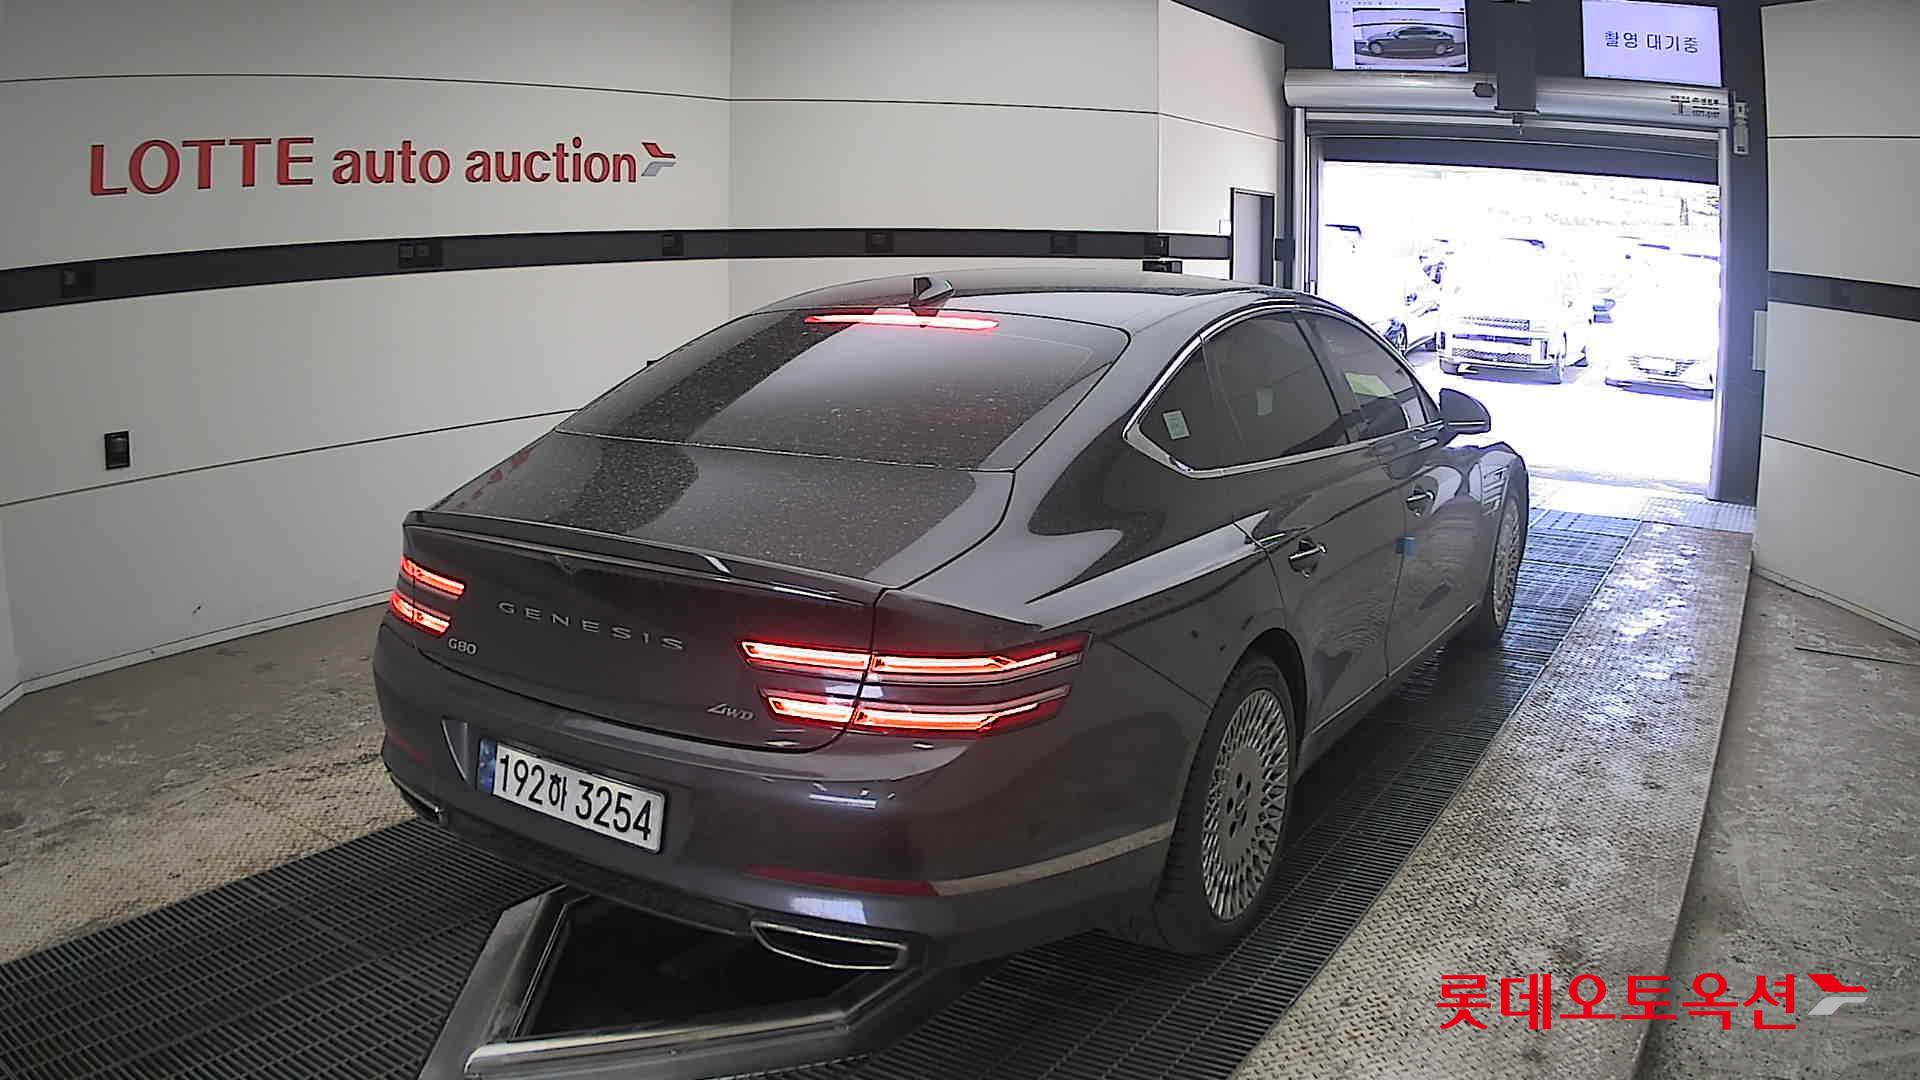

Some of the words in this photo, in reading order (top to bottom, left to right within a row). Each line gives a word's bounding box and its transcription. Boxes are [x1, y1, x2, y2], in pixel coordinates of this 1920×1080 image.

[89, 136, 315, 197] LOTTE
[331, 139, 451, 185] auto
[464, 136, 637, 185] auction
[447, 637, 478, 656] G80
[497, 600, 686, 651] GENESIS
[706, 702, 755, 721] 4WD
[499, 754, 567, 812] 192하
[574, 779, 652, 841] 3254
